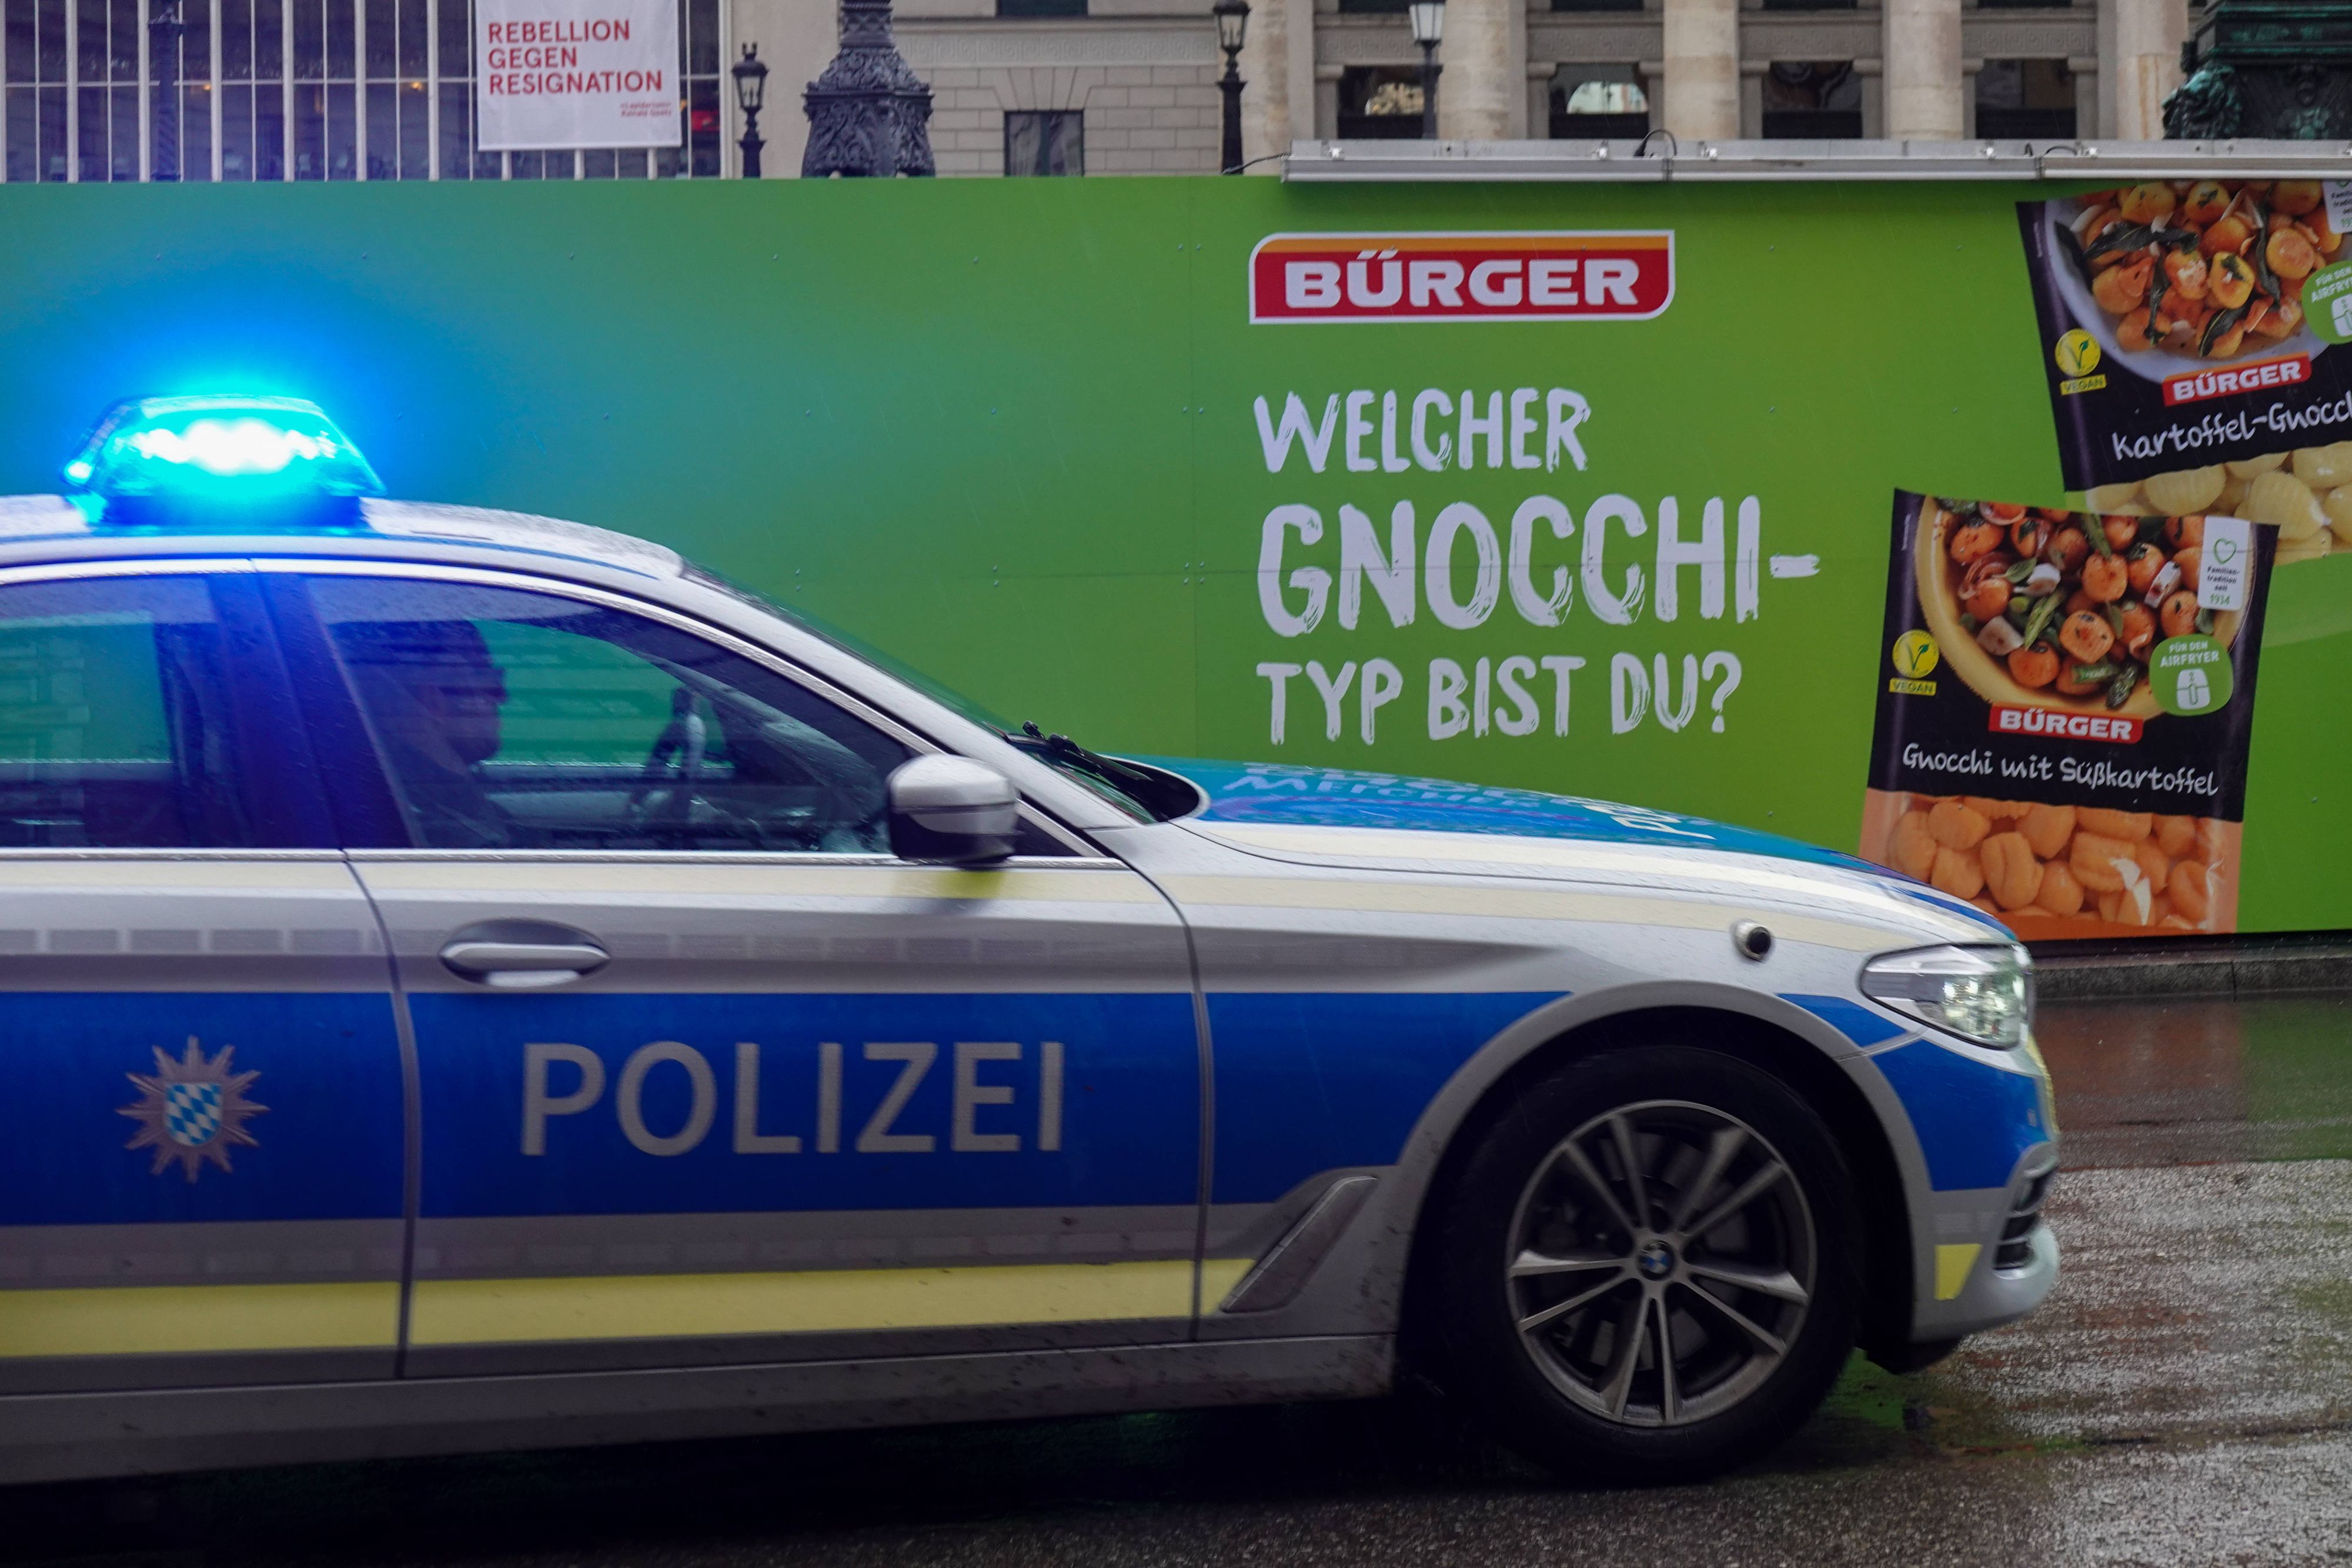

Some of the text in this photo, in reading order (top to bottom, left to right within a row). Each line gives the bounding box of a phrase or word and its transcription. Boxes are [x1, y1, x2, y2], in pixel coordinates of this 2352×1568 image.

[489, 19, 630, 44] REBELLION
[489, 46, 577, 69] GEGEN
[489, 70, 663, 95] RESIGNATION
[1285, 249, 1639, 309] BÜRGER
[2066, 377, 2103, 391] VEGAN
[2173, 360, 2301, 401] BÜRGER
[1253, 387, 1591, 473] WELCHER
[1257, 494, 1820, 637] GNOCCHI-
[2160, 650, 2220, 668] AIRFRYER
[2169, 642, 2187, 653] FÜR
[1257, 651, 1742, 745] TYP BIST DU?
[1895, 681, 1934, 693] VEGAN
[2000, 707, 2132, 740] BÜRGER
[1903, 742, 2219, 796] Gnocchi mit Süßkartoffel
[520, 1041, 1064, 1156] POLIZEI
